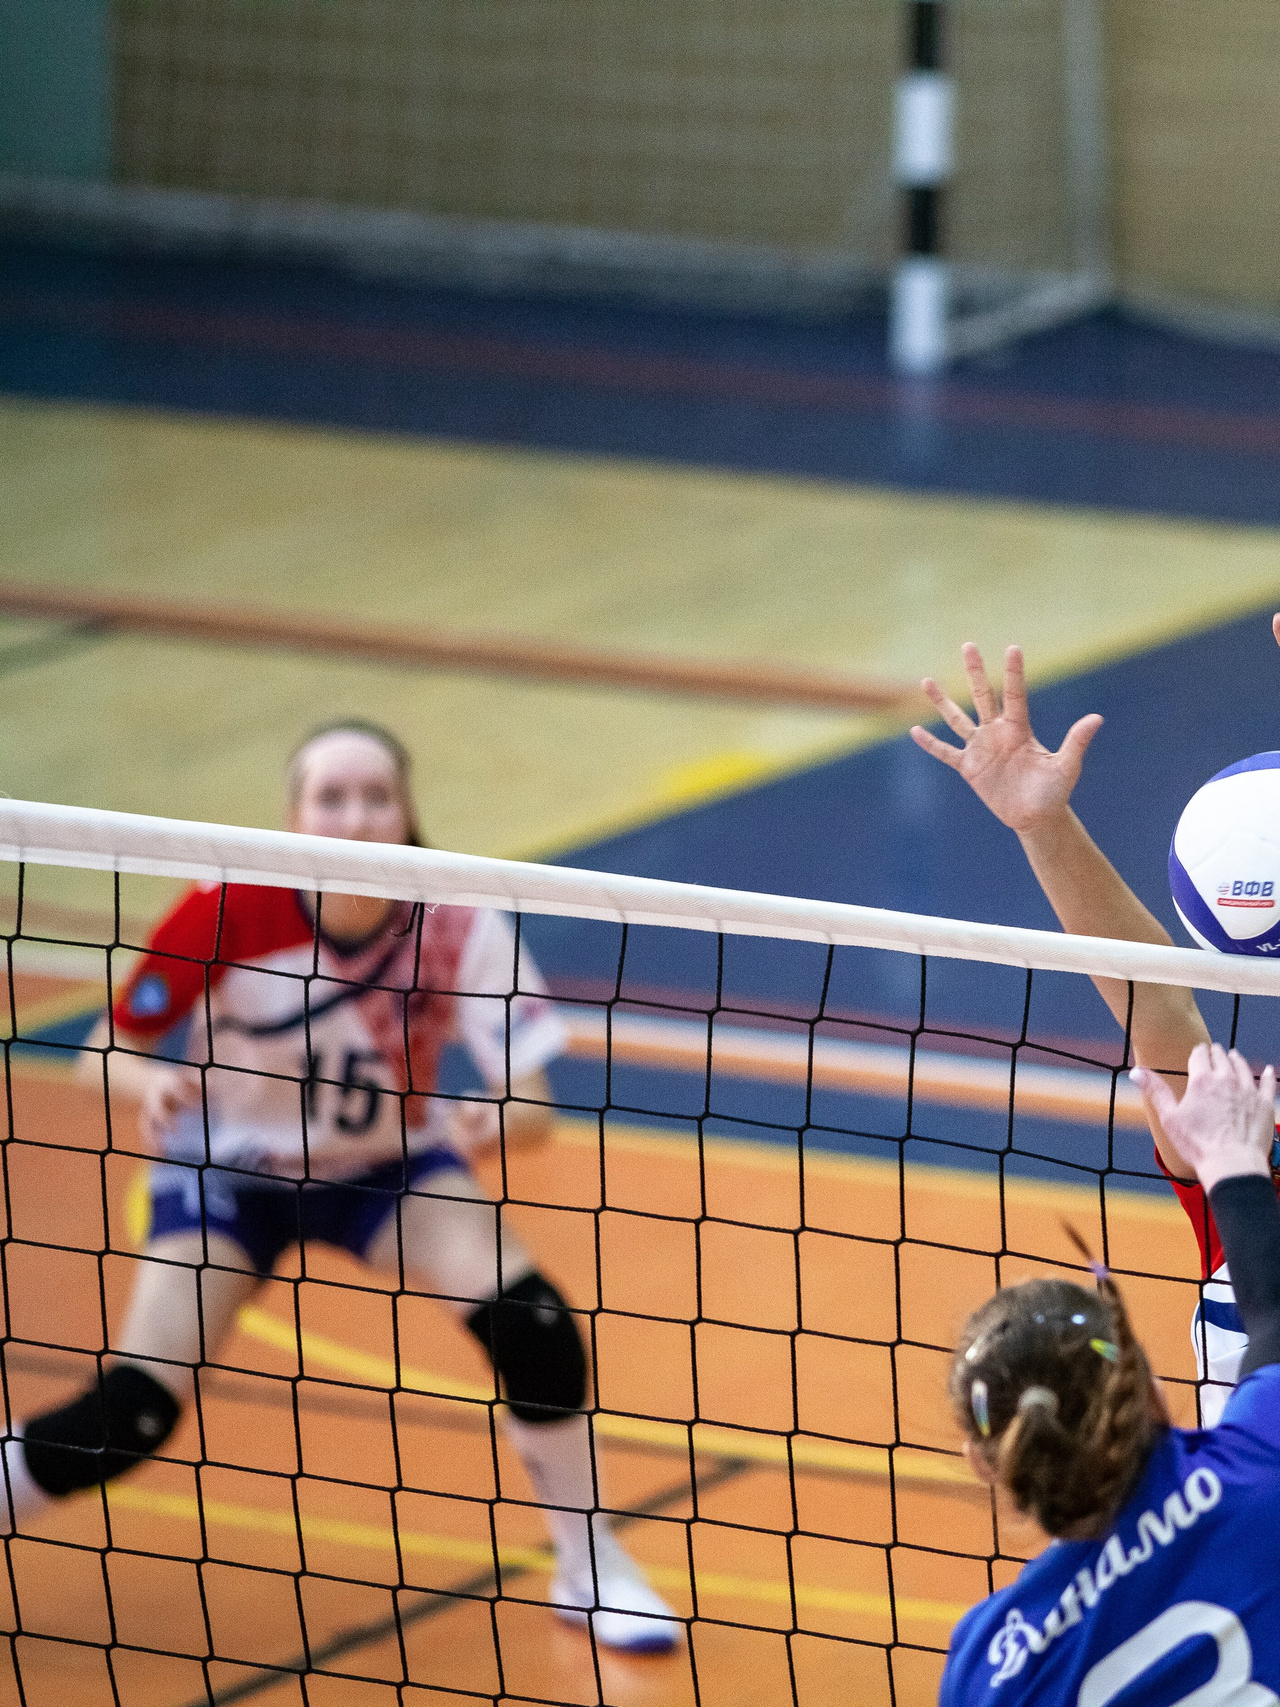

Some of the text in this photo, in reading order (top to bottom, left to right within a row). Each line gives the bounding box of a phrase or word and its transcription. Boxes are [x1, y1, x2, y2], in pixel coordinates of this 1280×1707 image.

[1232, 881, 1274, 896] ВФВ
[301, 1048, 387, 1136] 15
[988, 1467, 1222, 1688] Динамо
